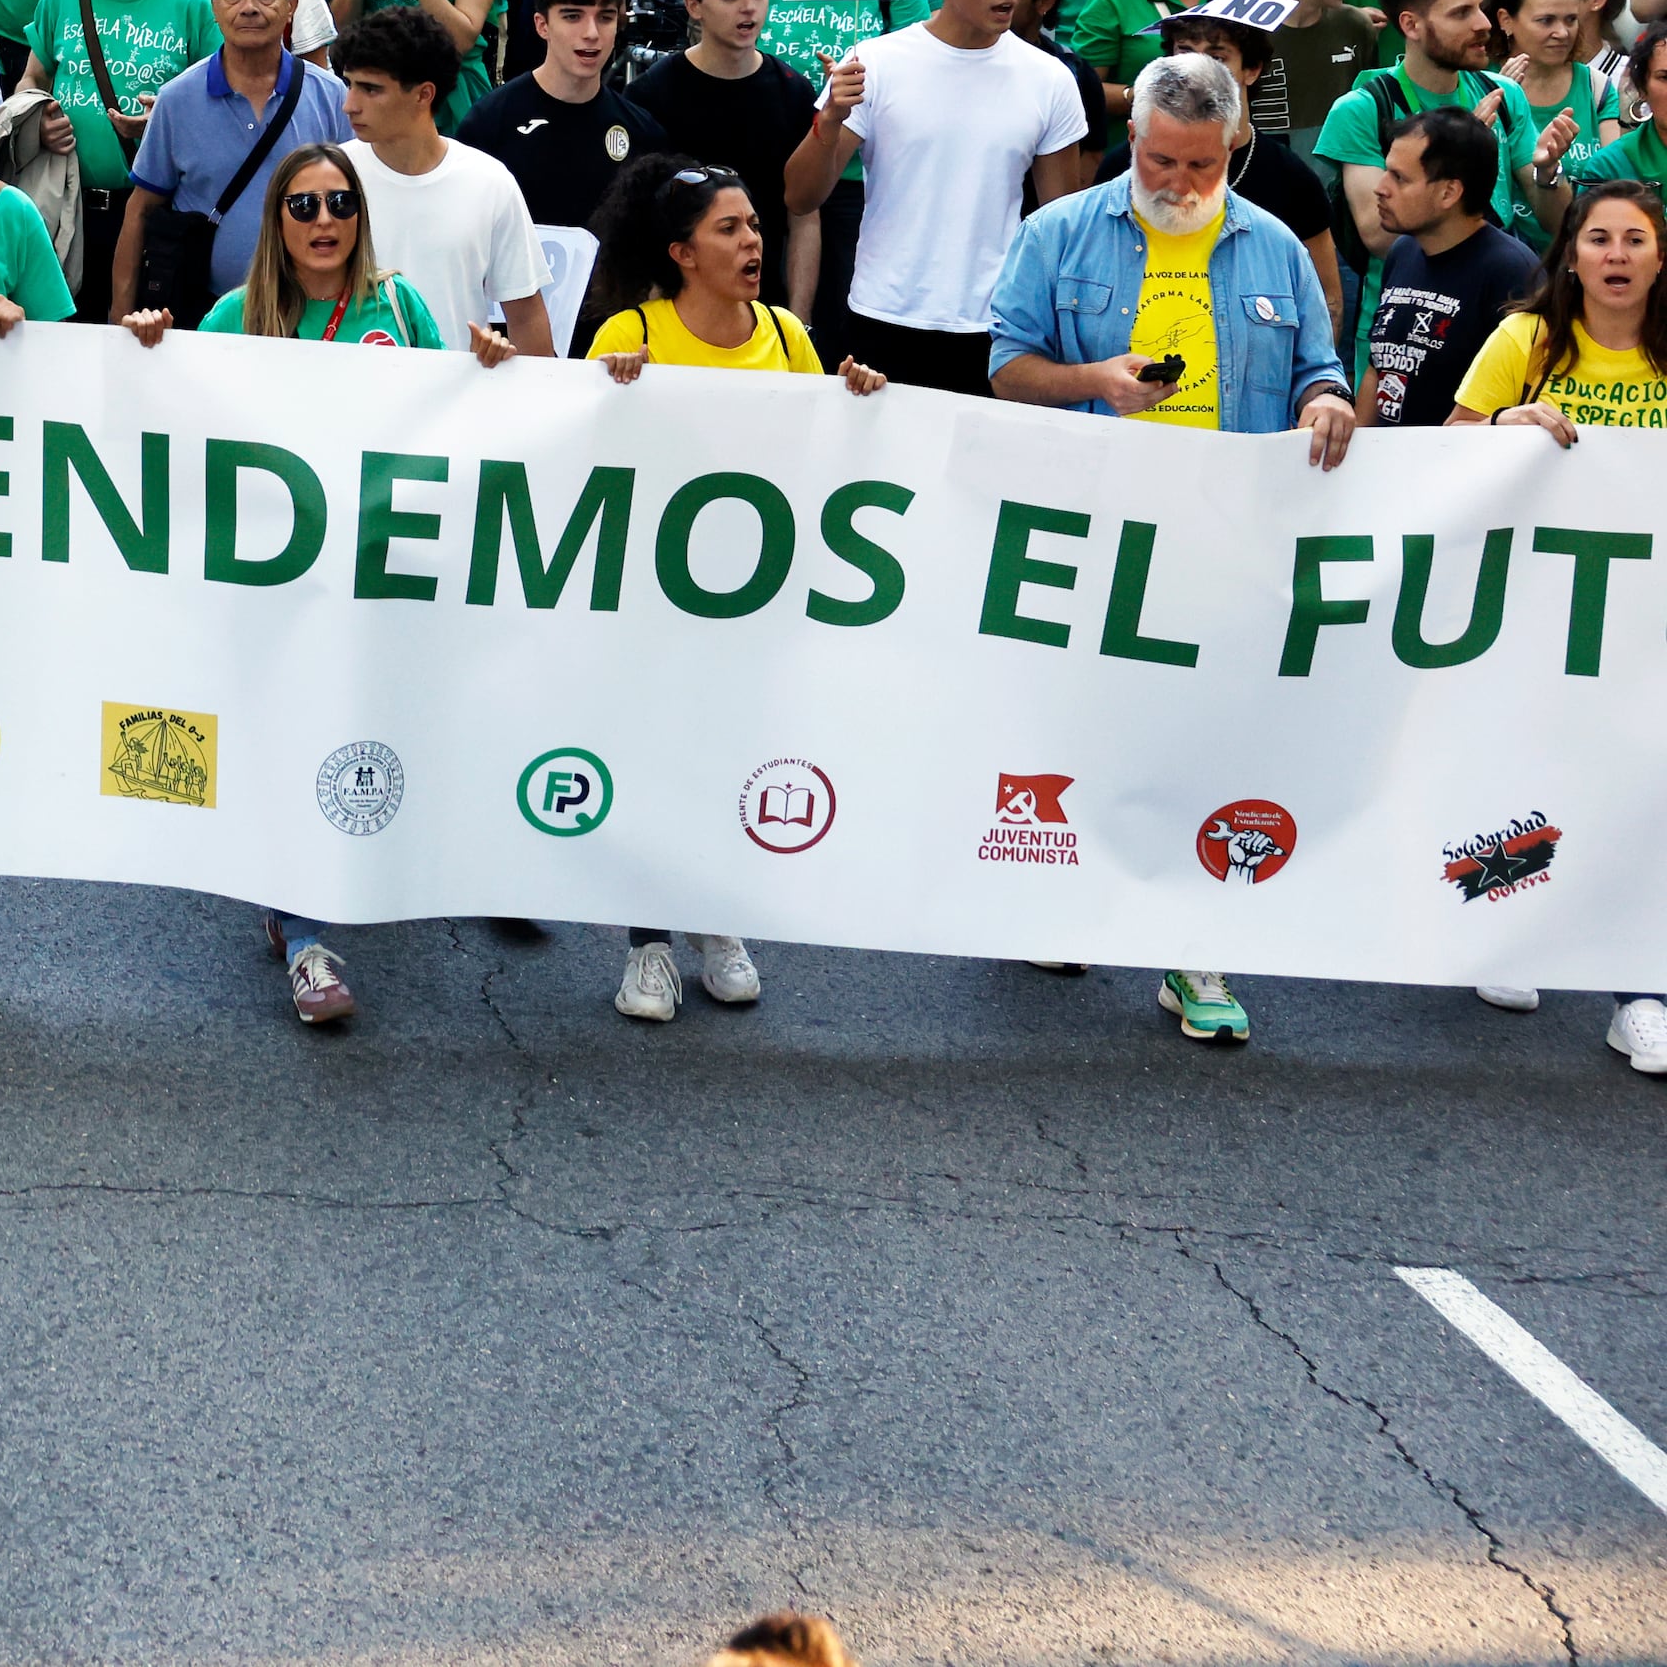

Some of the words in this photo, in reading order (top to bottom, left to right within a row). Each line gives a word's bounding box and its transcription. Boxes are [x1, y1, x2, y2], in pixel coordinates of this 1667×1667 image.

[769, 6, 825, 26] ESCUELA
[829, 11, 885, 33] PÚBLICA:
[1159, 402, 1215, 413] EDUCACIÓN
[1560, 403, 1666, 429] ESPECIA
[978, 499, 1201, 671] EL
[1277, 526, 1666, 678] FUT
[751, 758, 814, 779] ESTUDIANTES
[981, 829, 1078, 849] JUVENTUD
[1442, 810, 1547, 862] Solidaridad
[977, 845, 1080, 866] COMUNISTA
